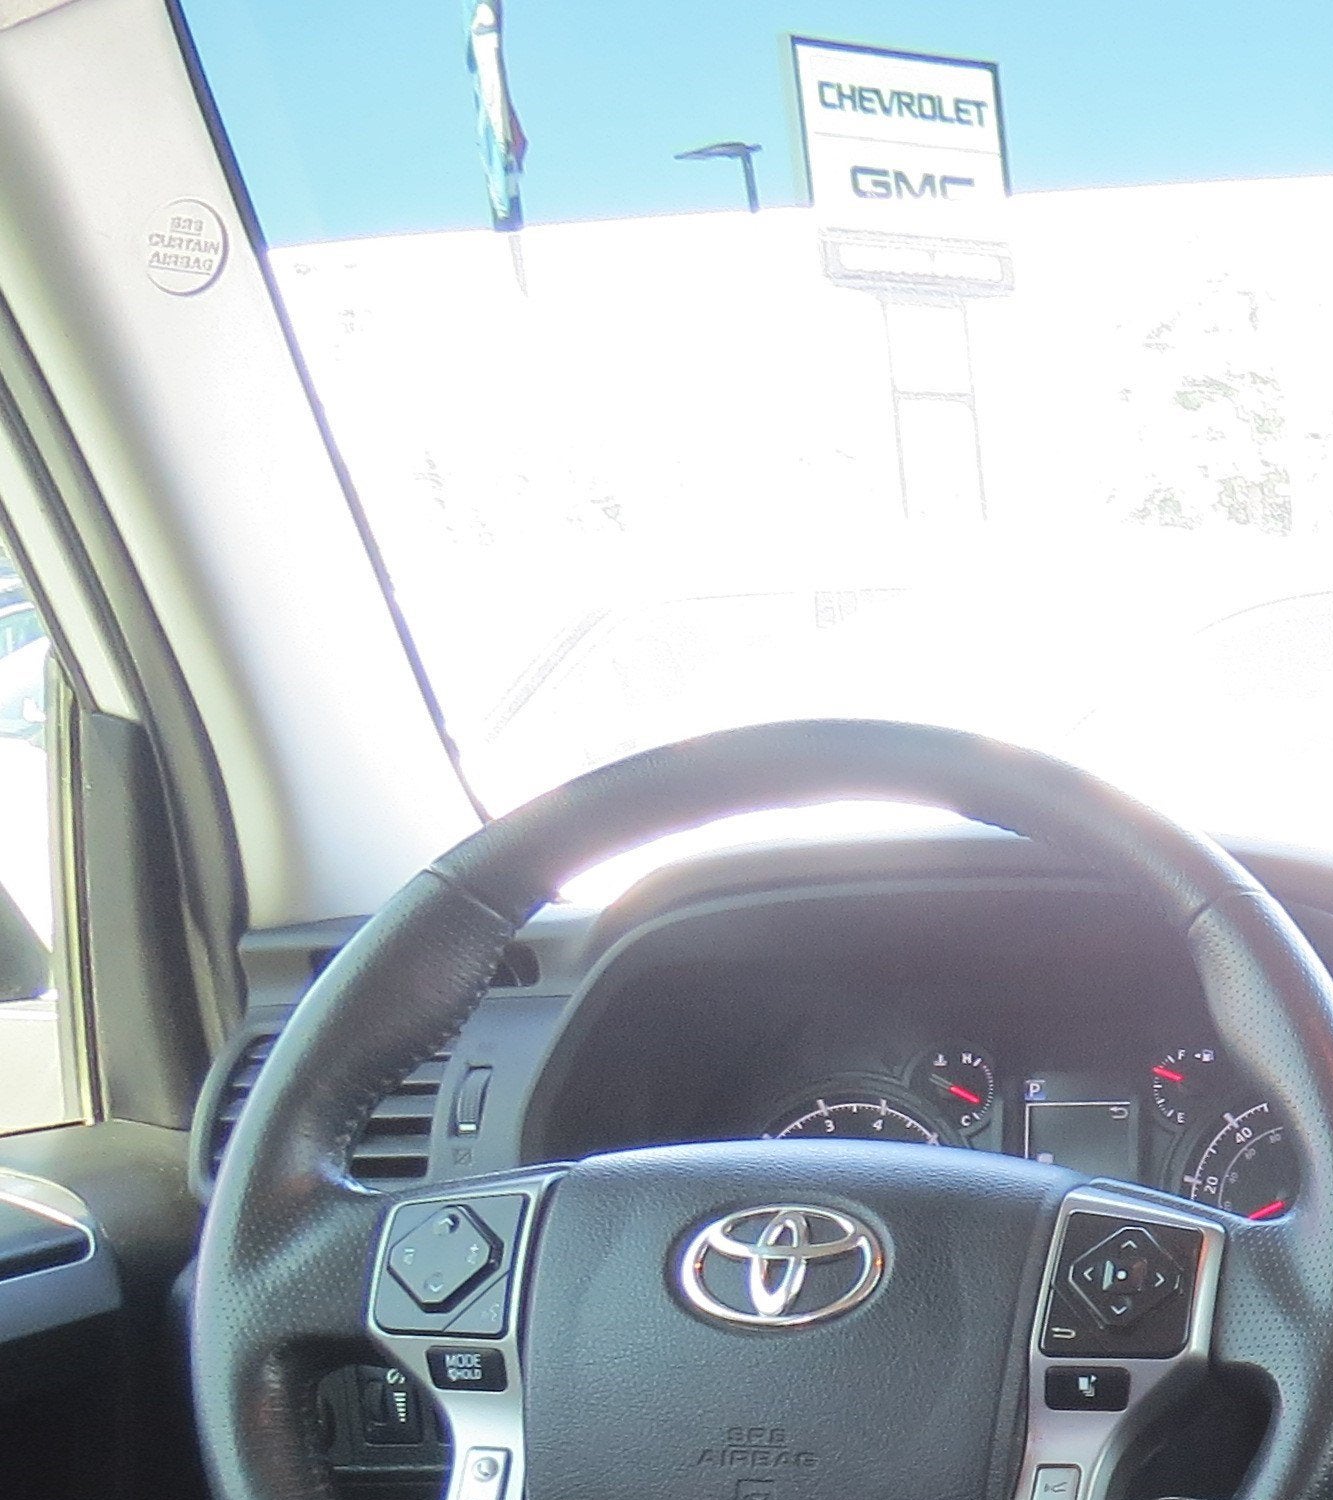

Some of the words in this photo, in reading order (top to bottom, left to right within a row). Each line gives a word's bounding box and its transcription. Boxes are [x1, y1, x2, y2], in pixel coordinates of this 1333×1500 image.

[817, 80, 988, 128] CHEVROLET
[850, 165, 975, 199] GMC
[962, 1053, 972, 1064] H
[1178, 1050, 1186, 1060] F
[1029, 1083, 1041, 1098] P
[961, 1115, 971, 1126] C
[1177, 1112, 1186, 1124] E
[824, 1119, 835, 1132] 3
[873, 1119, 884, 1131] 4
[1234, 1127, 1253, 1144] 40
[1203, 1176, 1219, 1194] 20
[445, 1354, 481, 1368] MODE
